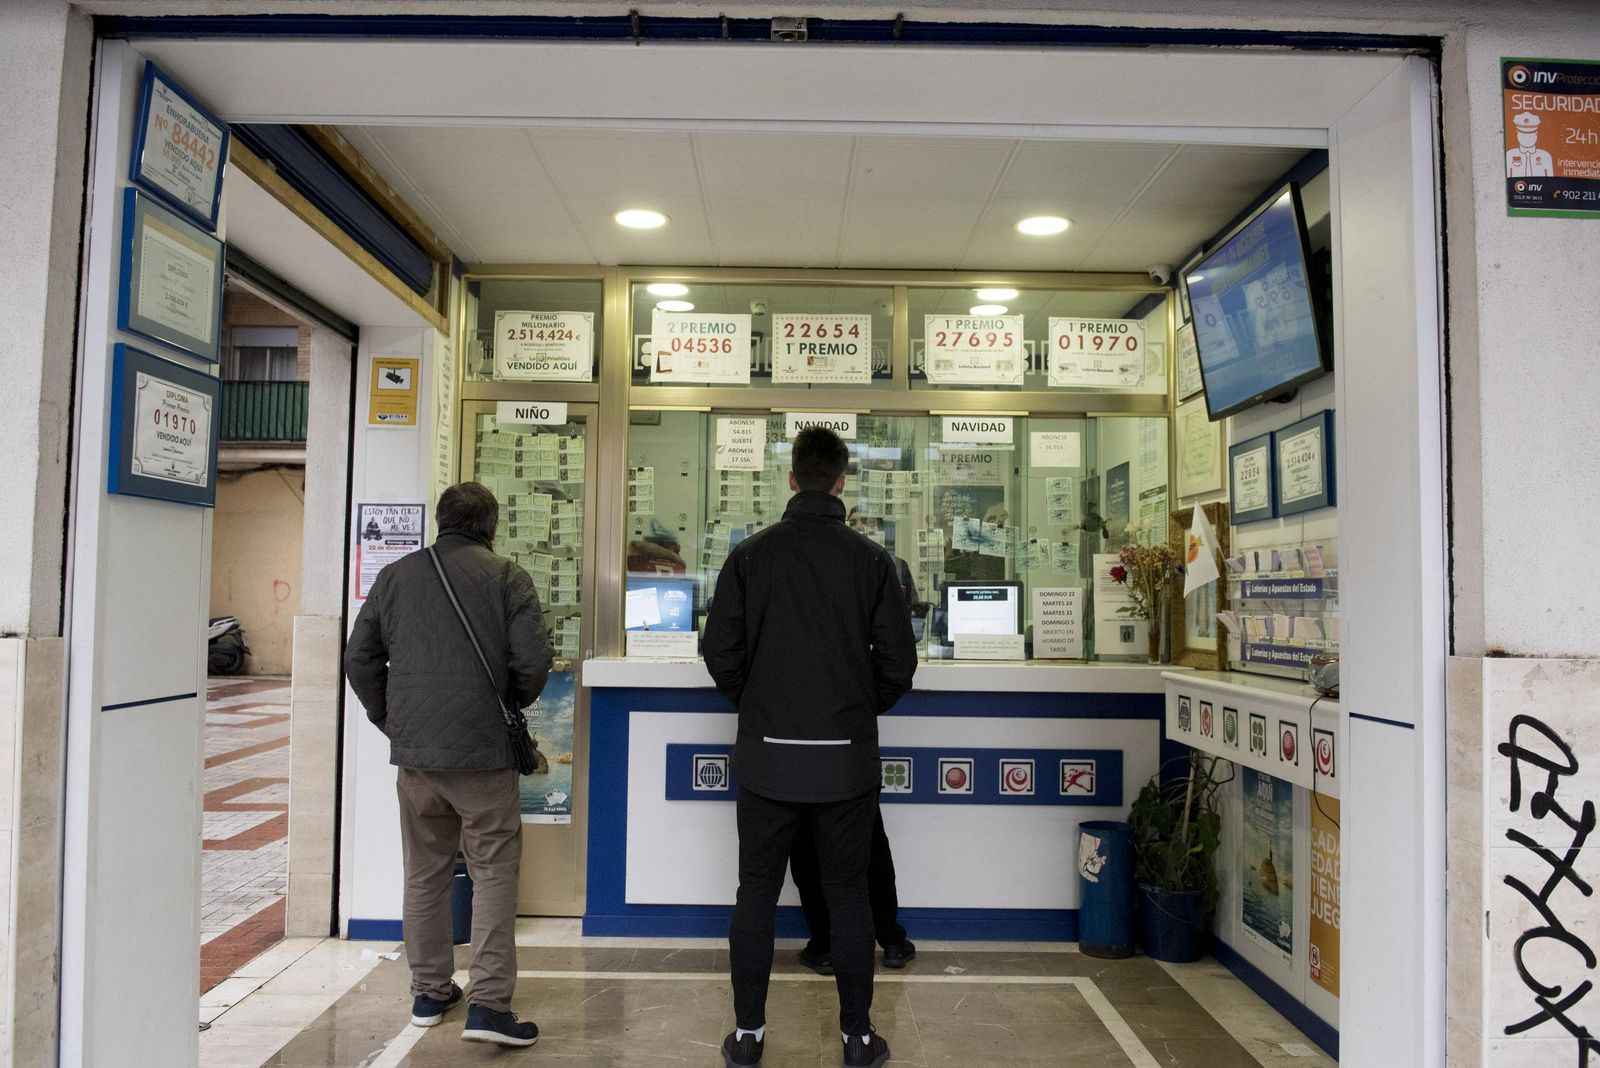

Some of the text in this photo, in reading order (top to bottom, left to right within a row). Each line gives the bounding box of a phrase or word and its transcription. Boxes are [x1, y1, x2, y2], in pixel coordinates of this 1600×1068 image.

[171, 122, 216, 171] 84442
[1557, 157, 1600, 169] intervenci
[1563, 167, 1600, 177] inmediat
[1562, 190, 1596, 201] 902 211
[680, 322, 737, 334] PREMIO
[784, 323, 860, 338] 22654
[955, 319, 1005, 330] PREMIO
[1079, 322, 1129, 334] PREMIO
[507, 329, 573, 341] 2.514.424
[935, 331, 1013, 347] 27695
[671, 337, 732, 354] 04536
[799, 343, 858, 355] PREMIO
[1058, 335, 1138, 351] 01970
[507, 360, 578, 371] VENDIDO AQUÍ
[166, 390, 188, 403] DIPLOMA
[515, 405, 550, 419] NIÑO
[154, 408, 196, 435] 01970
[951, 422, 1006, 433] NAVIDAD
[157, 431, 179, 444] VENDIDO
[951, 454, 992, 464] PREMIO
[1300, 583, 1317, 593] Estado
[1311, 826, 1340, 855] CAD
